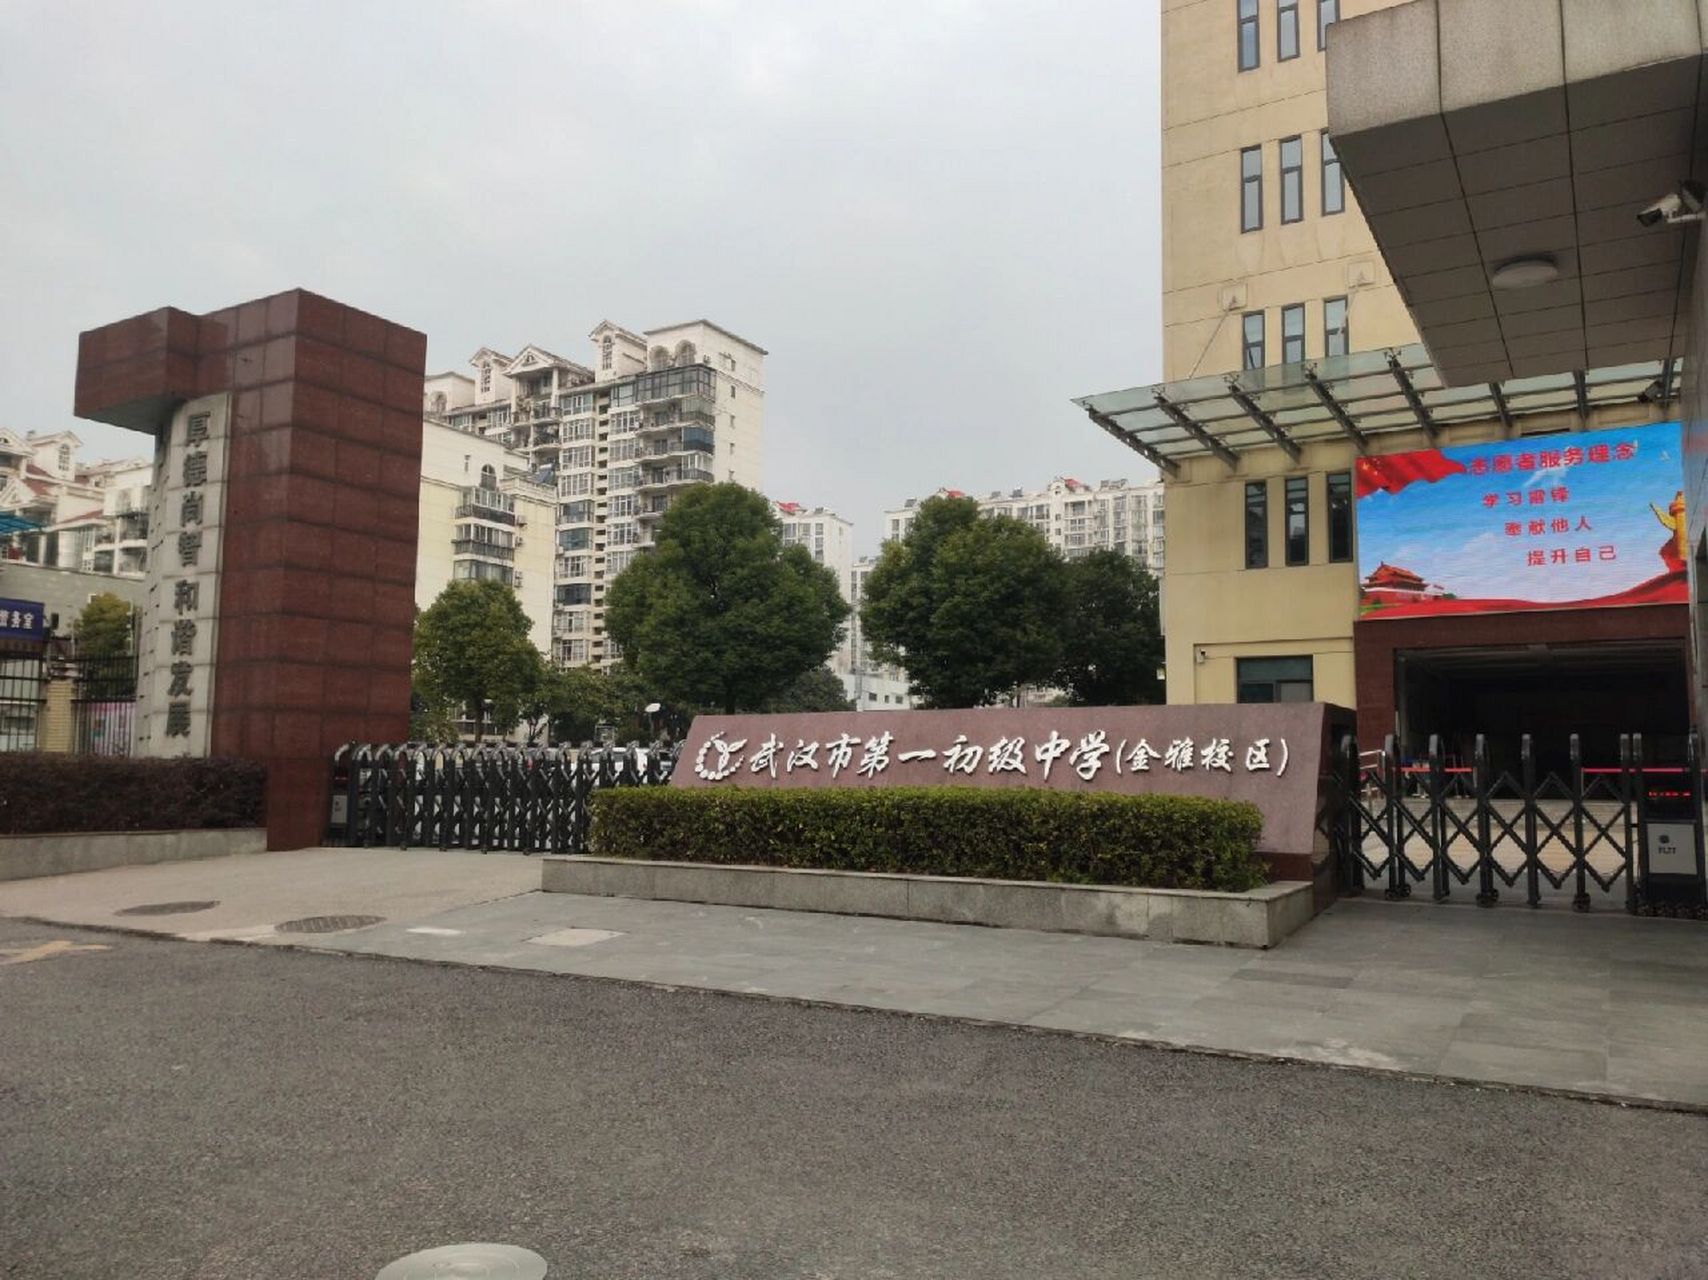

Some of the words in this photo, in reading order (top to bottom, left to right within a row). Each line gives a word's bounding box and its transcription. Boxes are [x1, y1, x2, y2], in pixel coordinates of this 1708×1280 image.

[1482, 486, 1569, 508] 学习雷锋
[1504, 515, 1592, 537] 奉献他人
[1527, 545, 1616, 566] 提升自己
